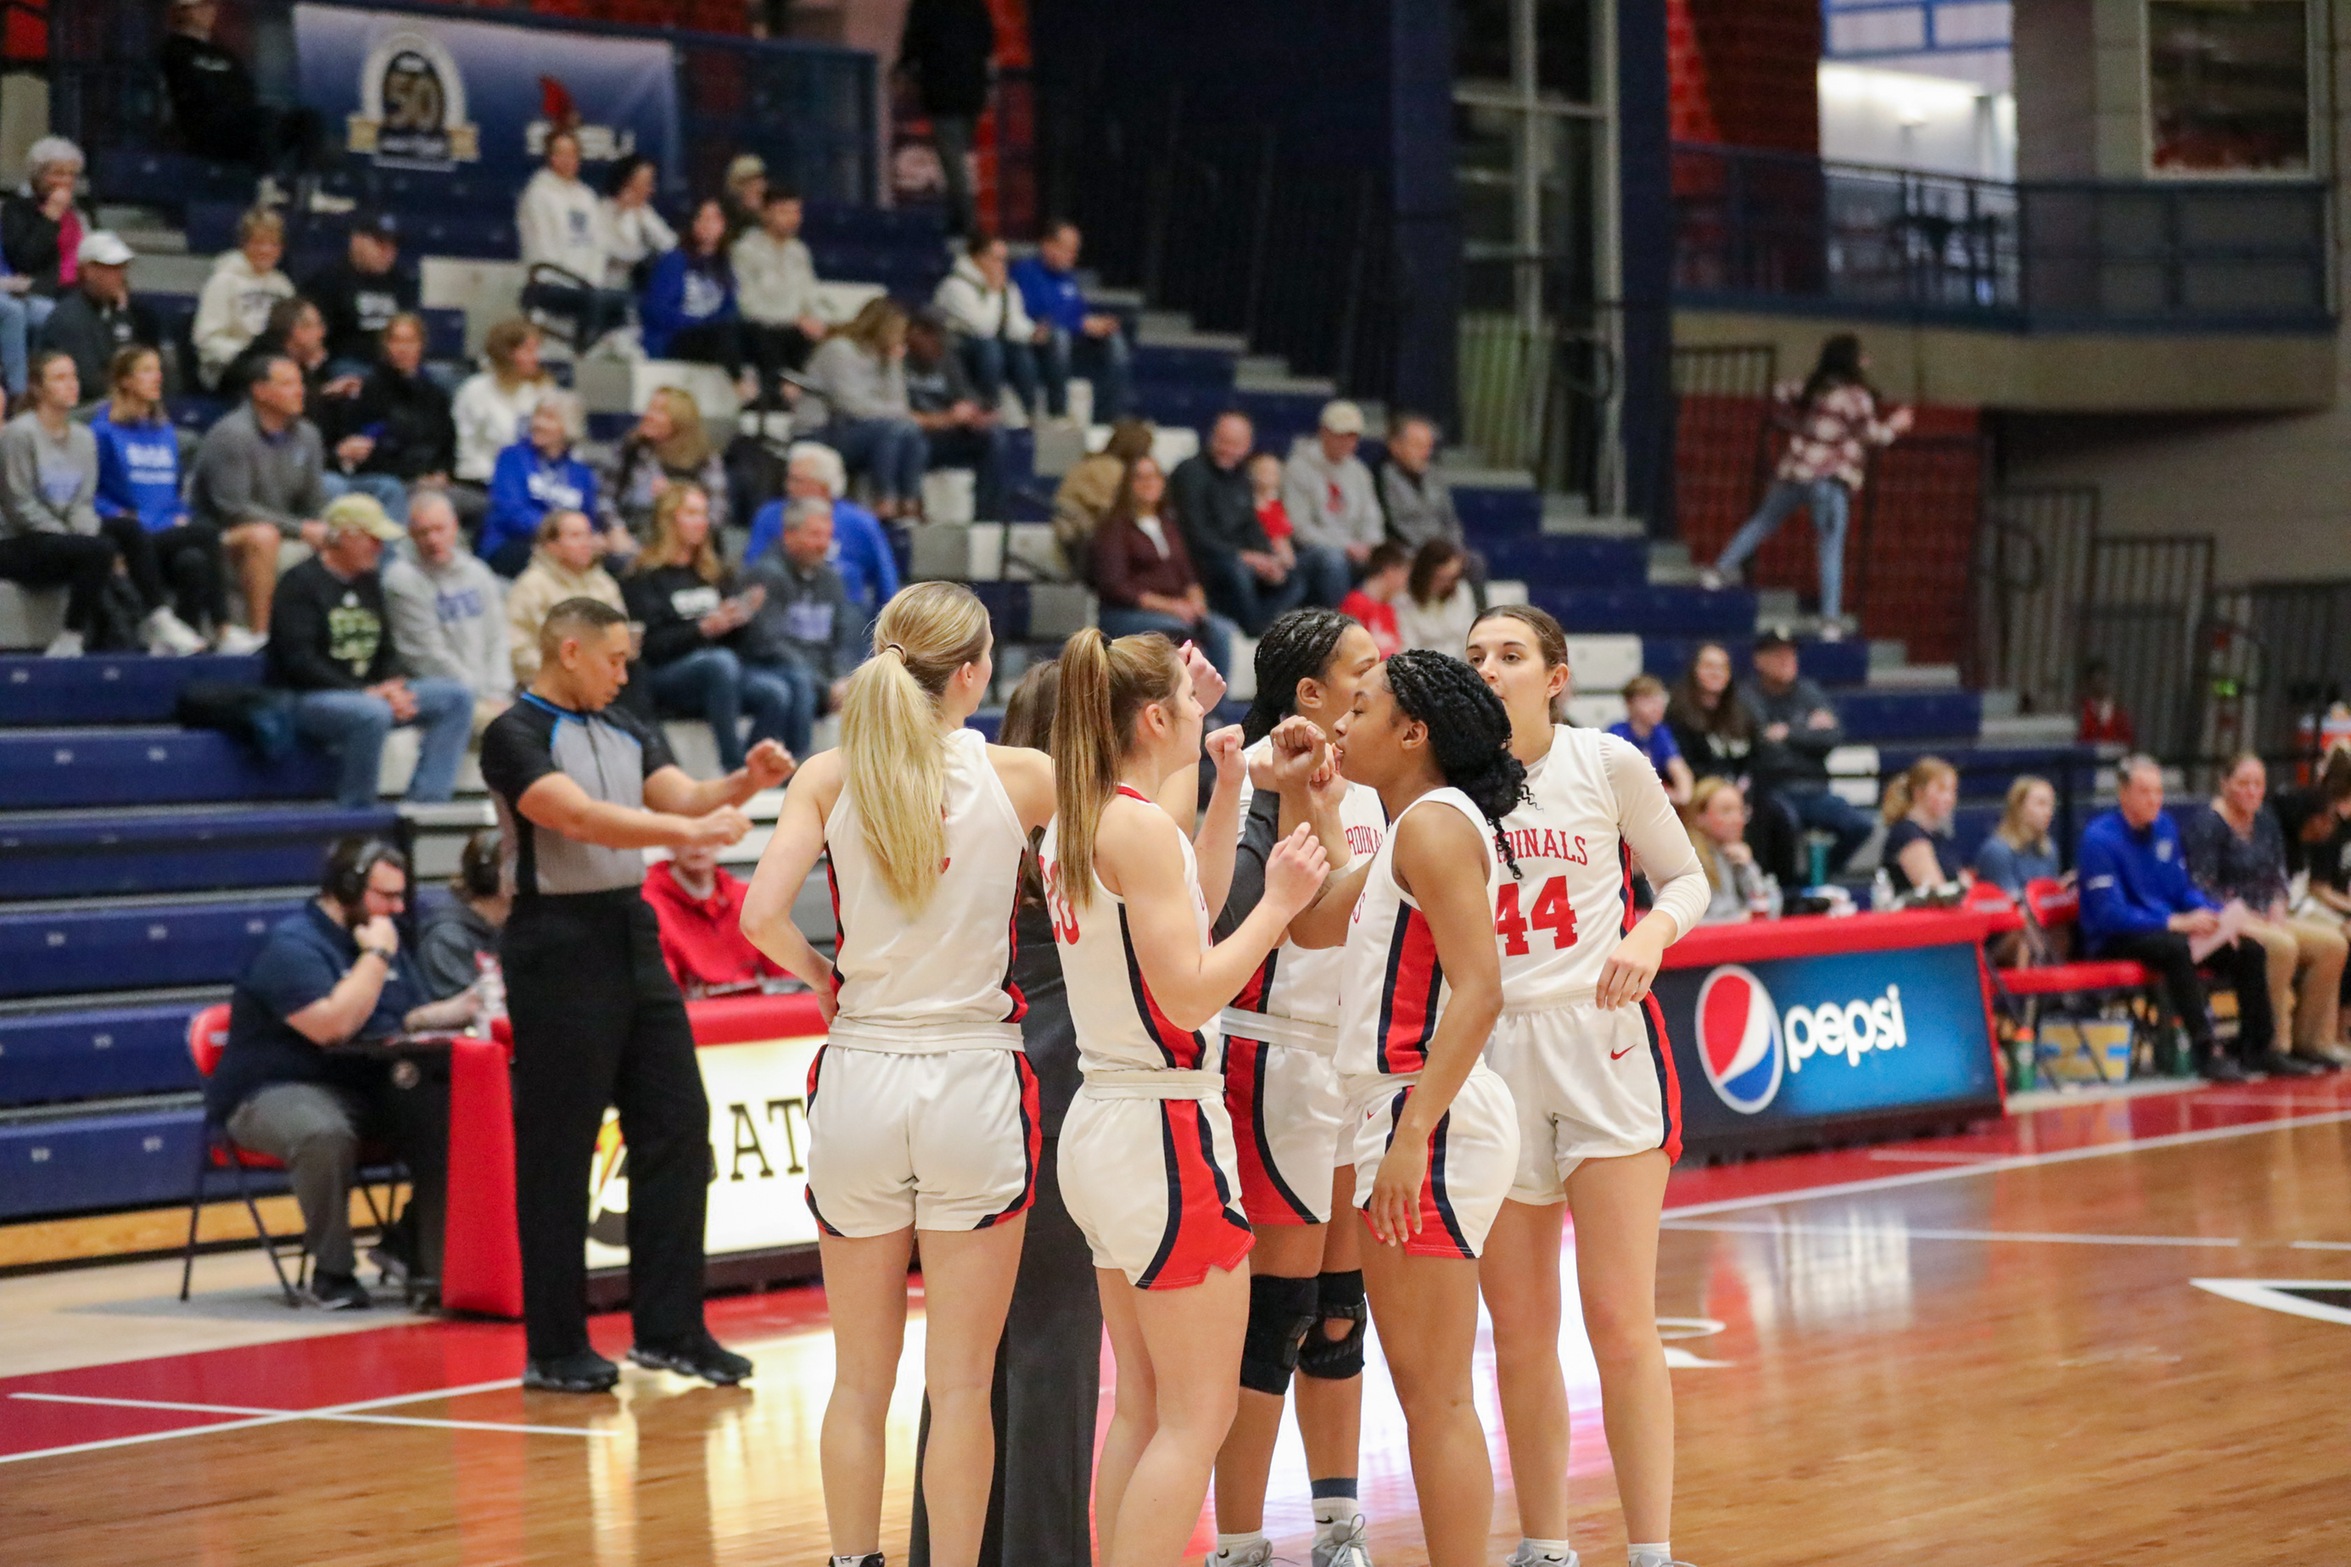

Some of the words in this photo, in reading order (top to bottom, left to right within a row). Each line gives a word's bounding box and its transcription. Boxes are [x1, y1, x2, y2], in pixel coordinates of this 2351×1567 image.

[1345, 825, 1385, 856] RDINA
[1494, 875, 1578, 957] 44
[1784, 984, 1907, 1073] pepsi
